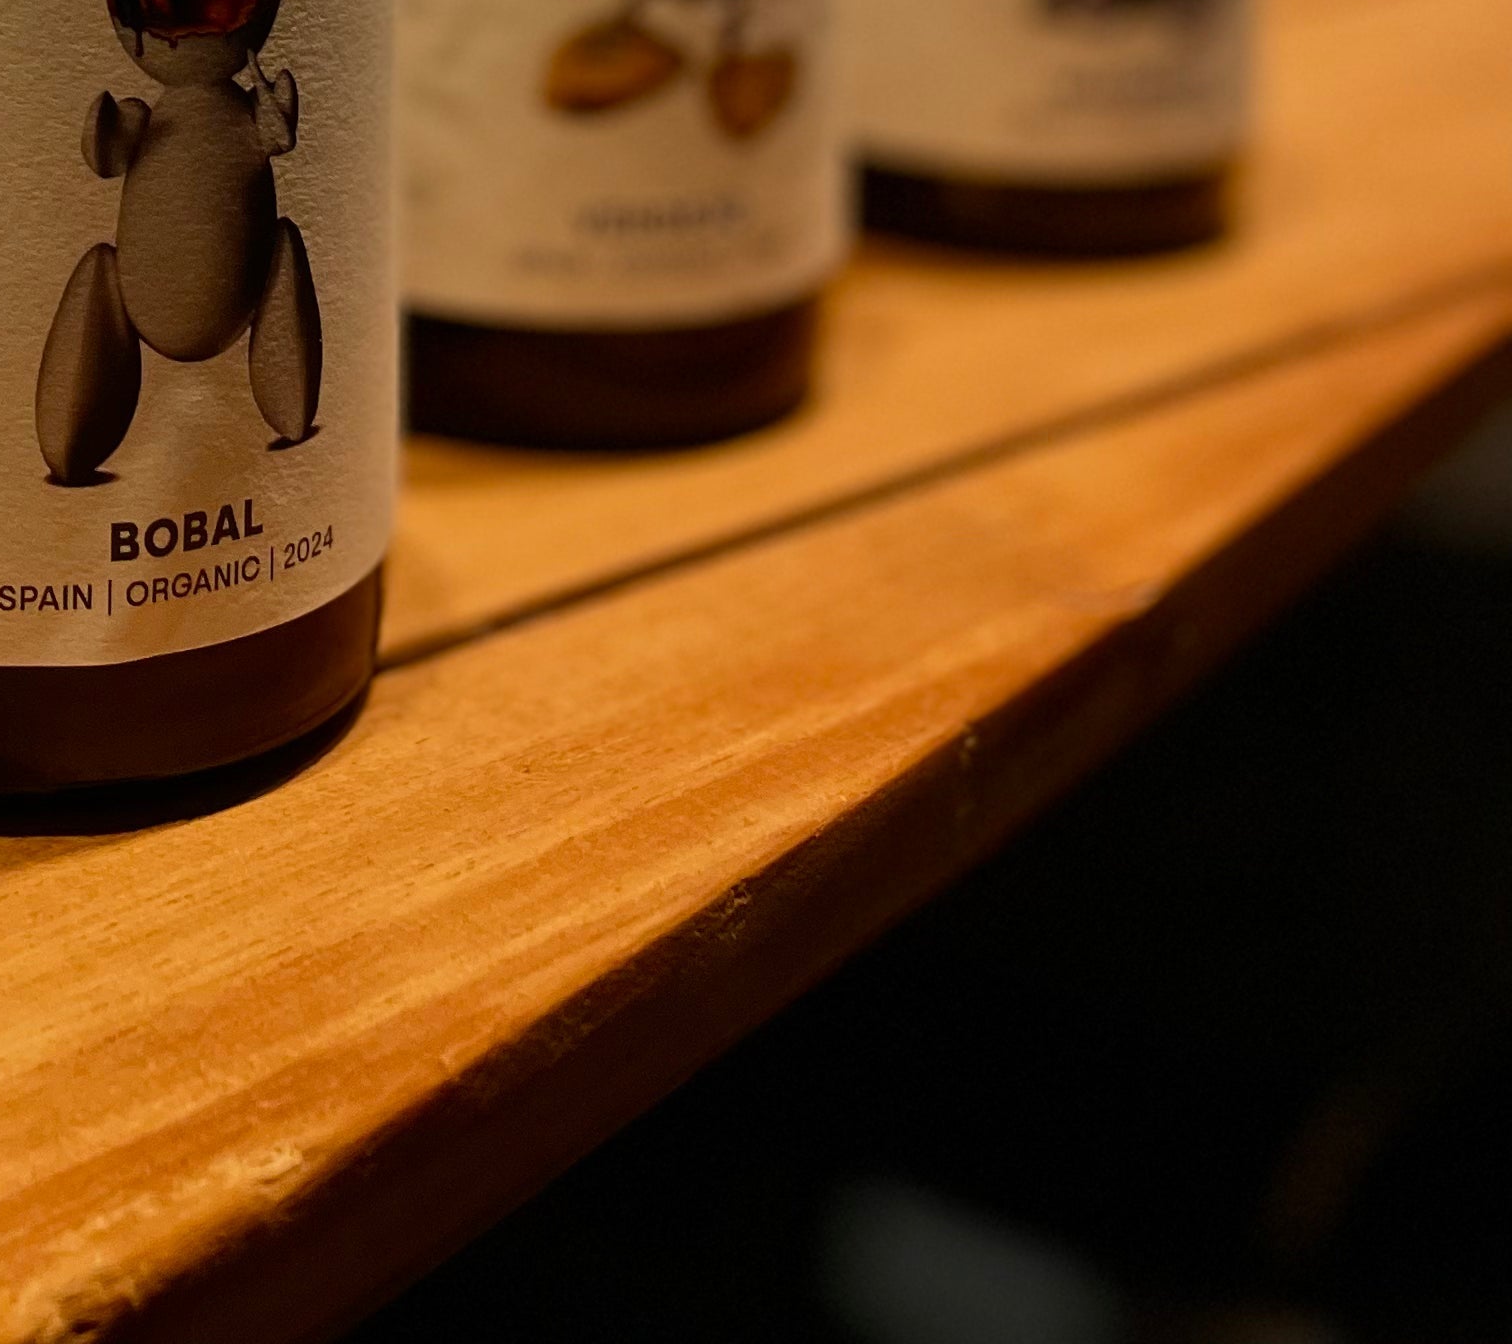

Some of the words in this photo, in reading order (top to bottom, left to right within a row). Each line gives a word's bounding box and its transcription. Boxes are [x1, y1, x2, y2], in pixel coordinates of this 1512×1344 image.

[110, 498, 264, 562] BOBAL
[125, 555, 261, 607] ORGANIC
[283, 525, 334, 570] 2024
